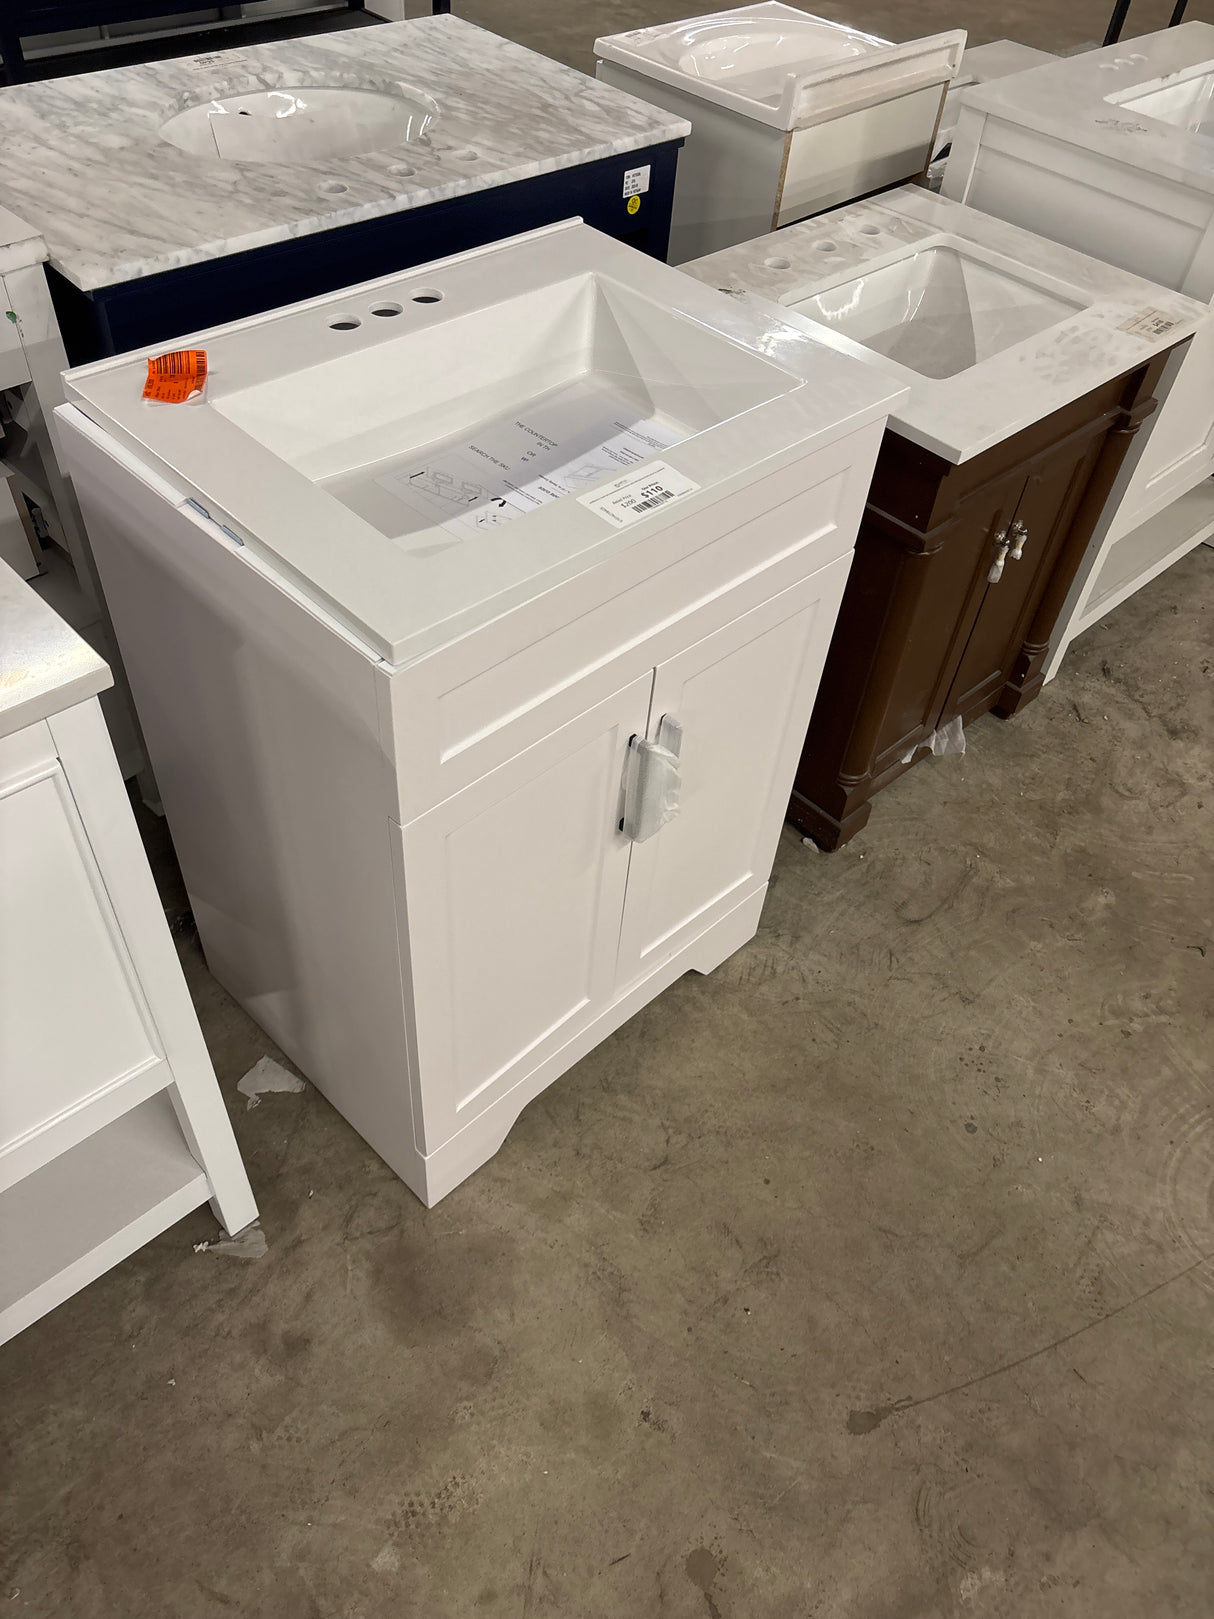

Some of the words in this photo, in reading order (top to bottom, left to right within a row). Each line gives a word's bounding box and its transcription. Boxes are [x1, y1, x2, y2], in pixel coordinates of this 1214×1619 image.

[515, 421, 525, 429] THE
[525, 427, 558, 446] COUNTERTOP
[468, 445, 489, 458] SEARCH
[489, 456, 499, 464] THE
[498, 463, 511, 471] SKU
[640, 485, 664, 498] $110
[620, 498, 637, 509] $200
